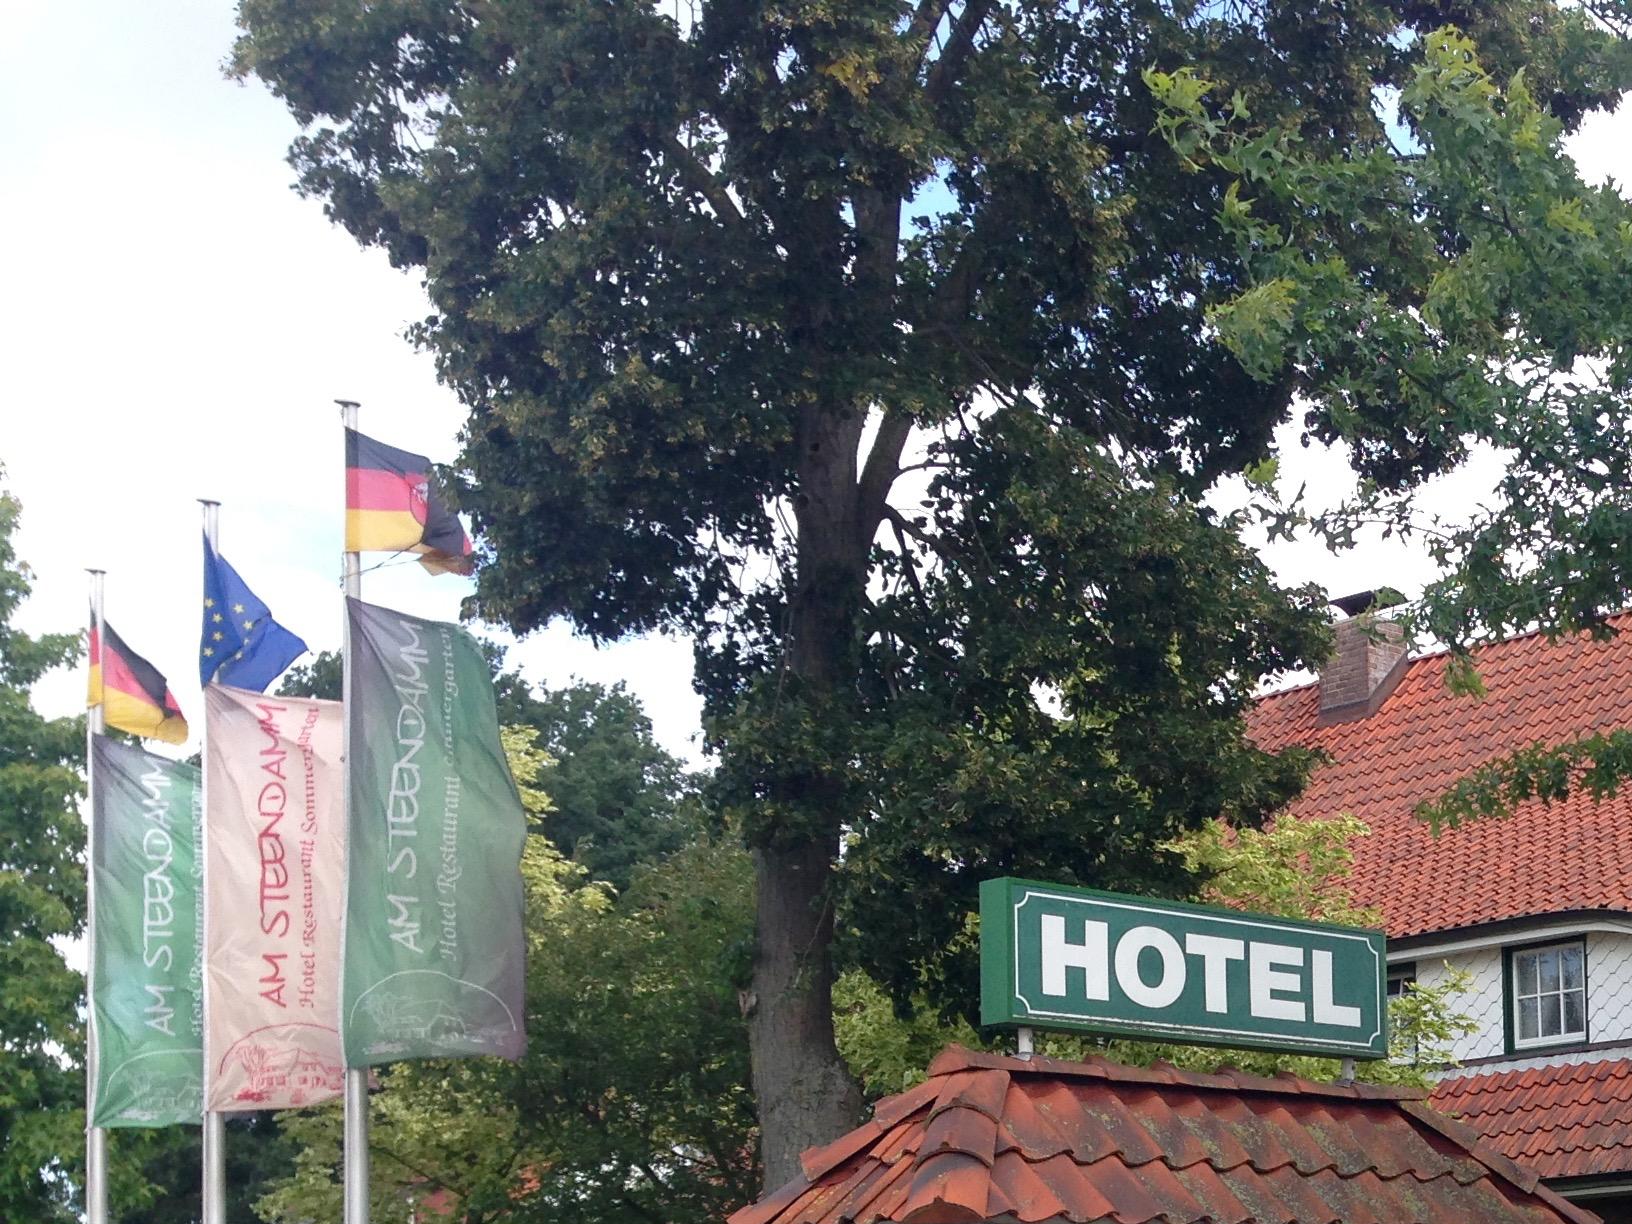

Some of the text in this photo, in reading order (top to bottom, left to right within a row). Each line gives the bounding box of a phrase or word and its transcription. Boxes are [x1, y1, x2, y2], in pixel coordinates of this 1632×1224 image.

[387, 620, 429, 954] AM STEENDAMM
[437, 776, 462, 894] Restaurant
[143, 756, 176, 1036] AM STEENDAMM
[257, 703, 289, 1008] AM STEENDAMM
[299, 840, 317, 948] Restaurant
[299, 952, 316, 1008] Hotel
[439, 901, 458, 961] Hotel
[1041, 913, 1361, 1028] HOTEL
